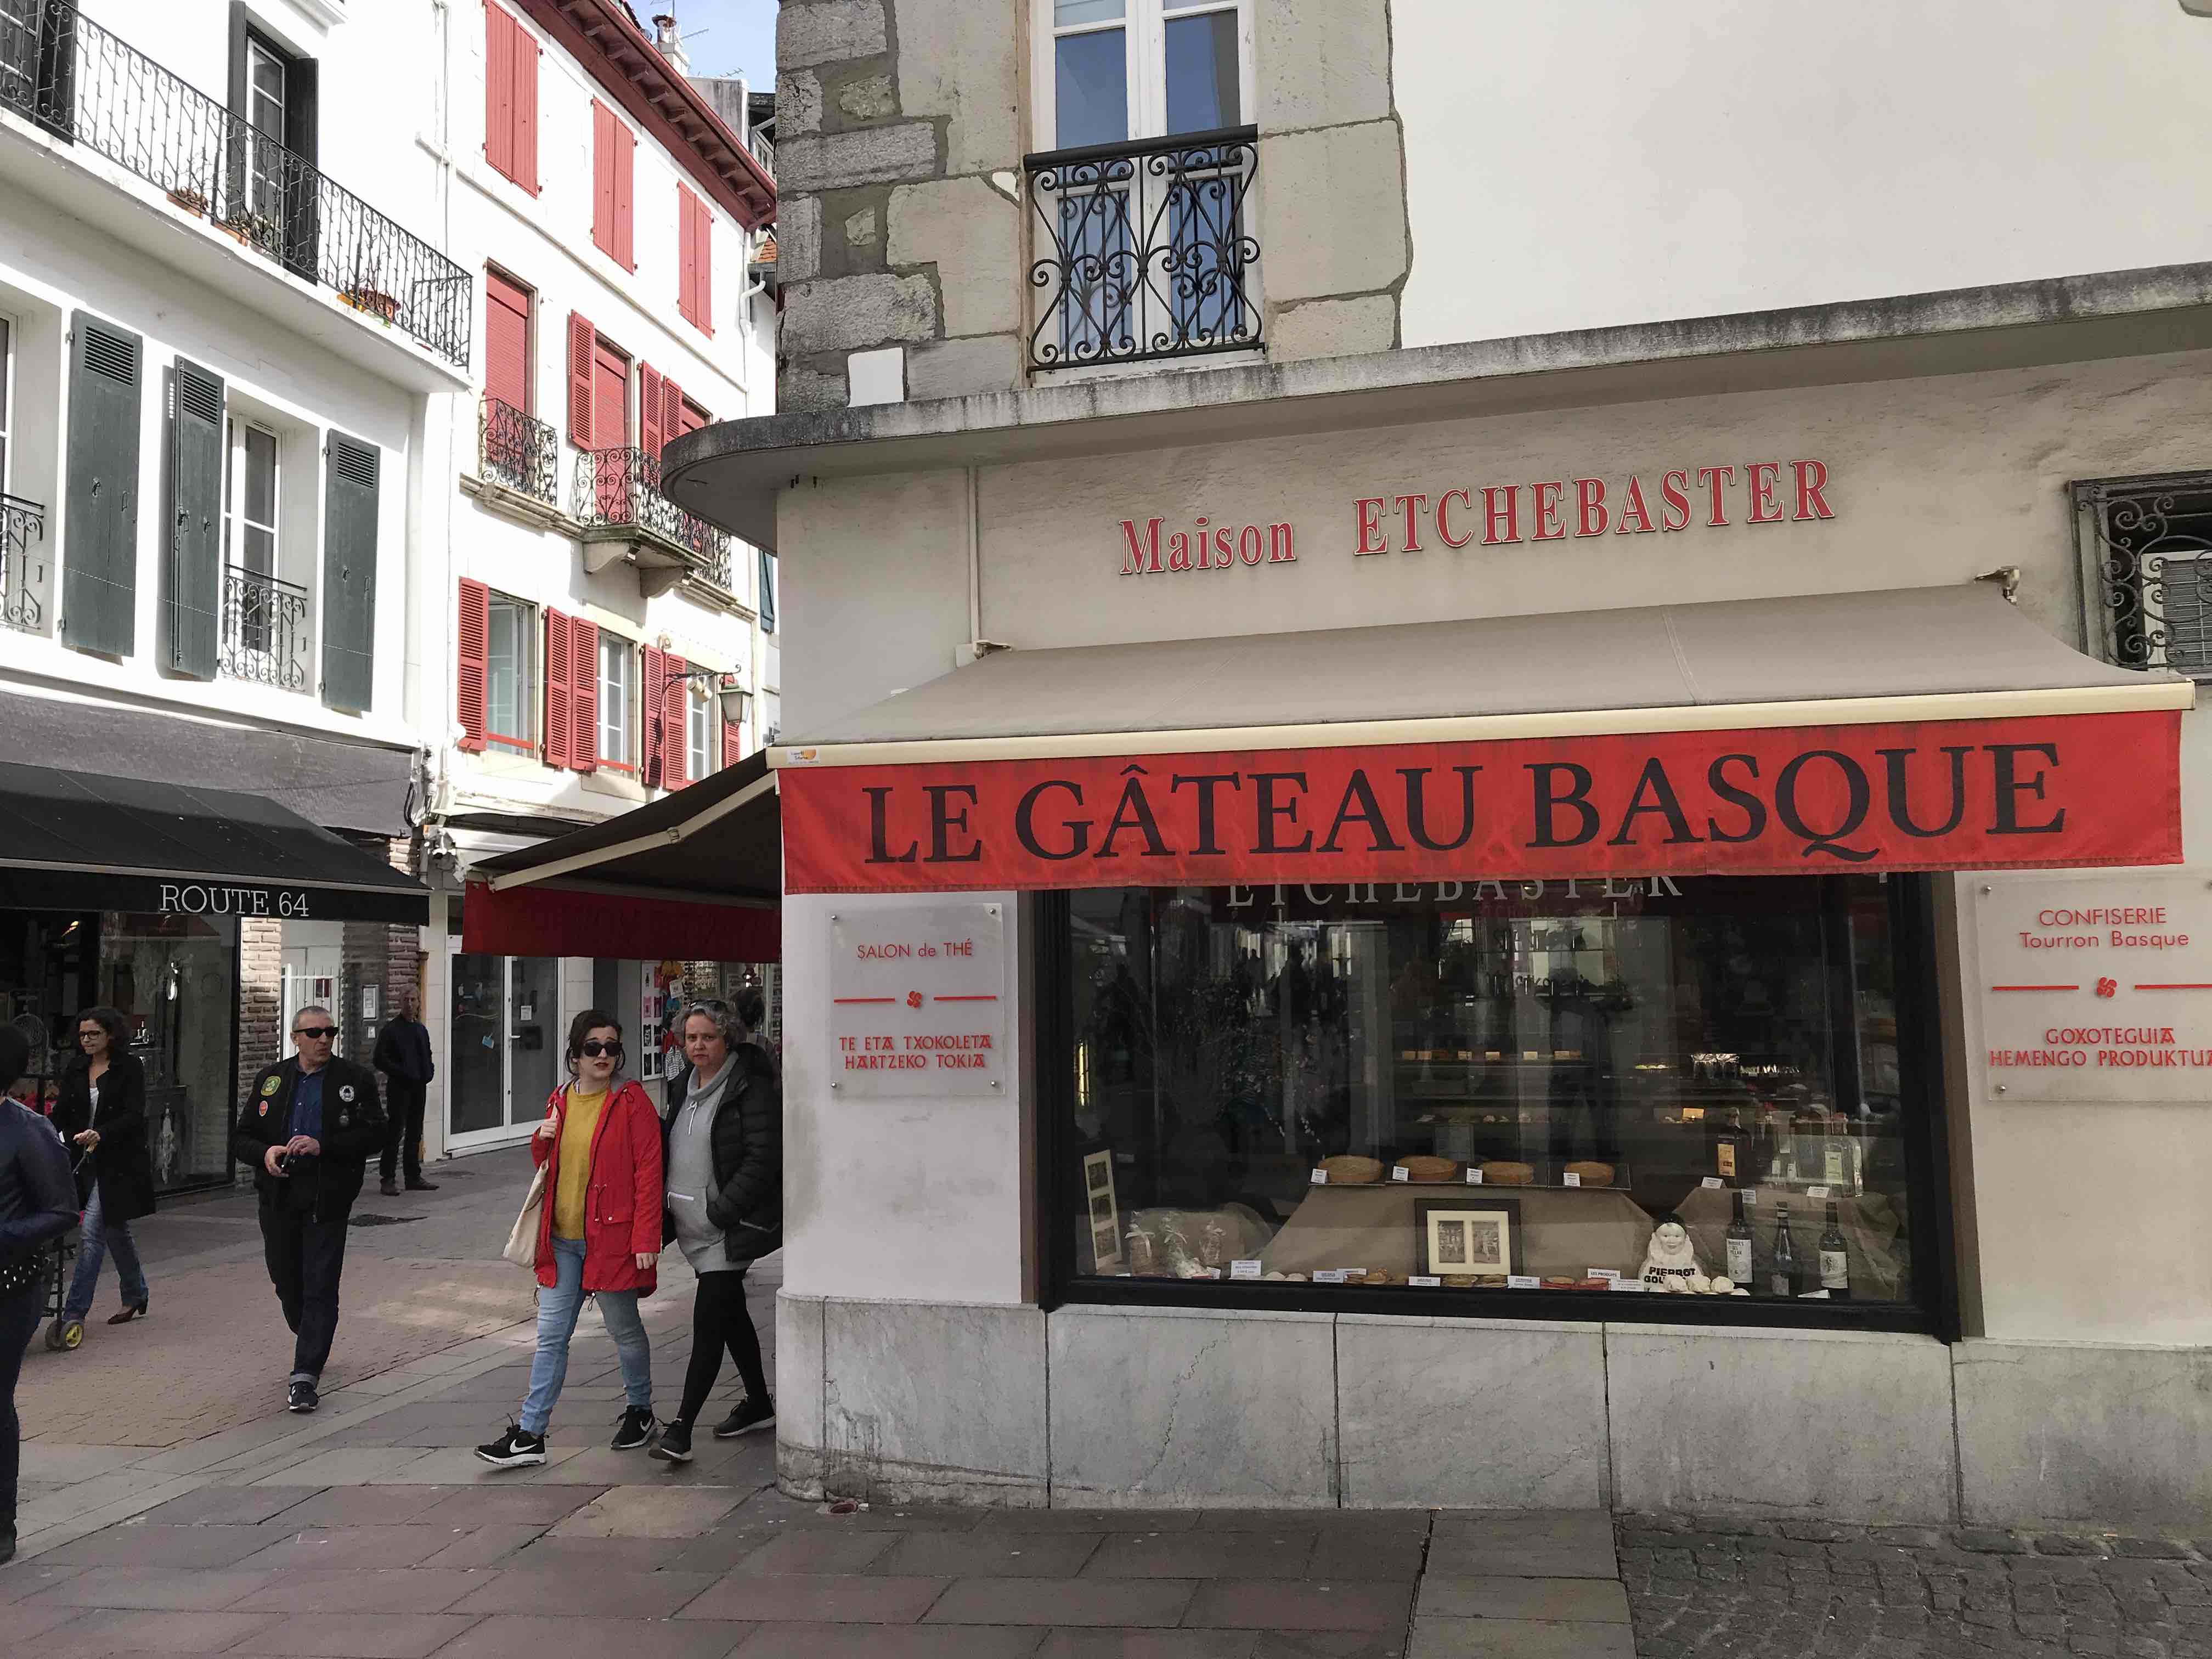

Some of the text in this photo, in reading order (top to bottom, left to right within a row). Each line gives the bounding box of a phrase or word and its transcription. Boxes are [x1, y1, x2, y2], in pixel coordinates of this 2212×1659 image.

[1119, 459, 1835, 575] Maison ETCHEBASTER
[864, 743, 2065, 864] LE GÂTEAU BASQUE
[159, 884, 309, 917] ROUTE 64
[2039, 907, 2166, 926] CONFISERIE
[857, 938, 972, 959] SALON de THÉ
[2019, 930, 2190, 949] Tourron Basque
[839, 1035, 992, 1051] TE ETA TXOKOLETA
[2046, 1028, 2176, 1045] GOXOTEGUIA
[845, 1054, 926, 1069] HARTZEKO
[1989, 1050, 2087, 1066] HEMENGO
[1649, 1266, 1695, 1277] PIERROT
